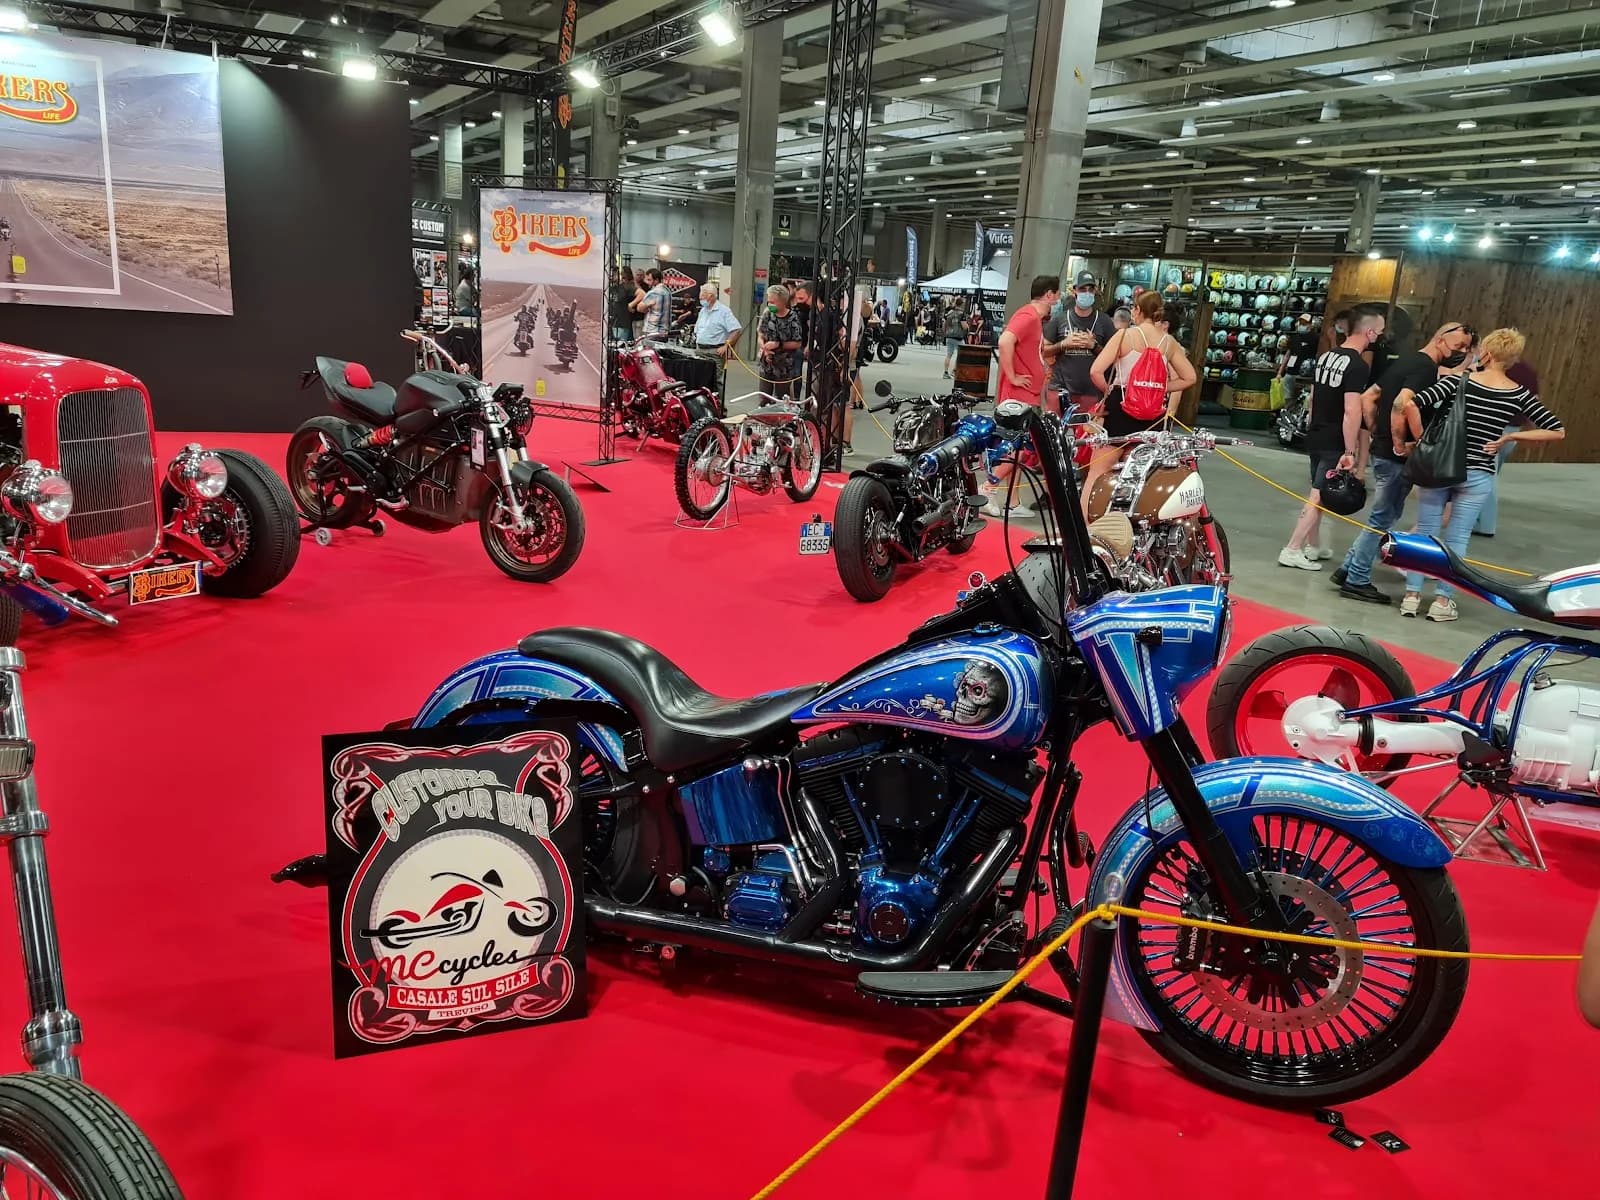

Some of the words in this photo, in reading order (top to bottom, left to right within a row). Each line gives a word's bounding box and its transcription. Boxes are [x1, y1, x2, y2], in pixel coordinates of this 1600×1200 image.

[43, 111, 60, 120] LIFE
[420, 219, 444, 233] CUSTOM
[492, 205, 592, 258] BIKERS
[1179, 487, 1202, 505] HARLEY
[801, 539, 828, 551] 68335
[133, 568, 195, 602] BIKERS
[427, 788, 494, 832] YOUR
[1185, 926, 1199, 960] brembo
[396, 988, 458, 1007] CASALE
[461, 986, 492, 1004] SUL
[495, 969, 530, 994] SILE
[436, 1002, 490, 1018] TREVISO
